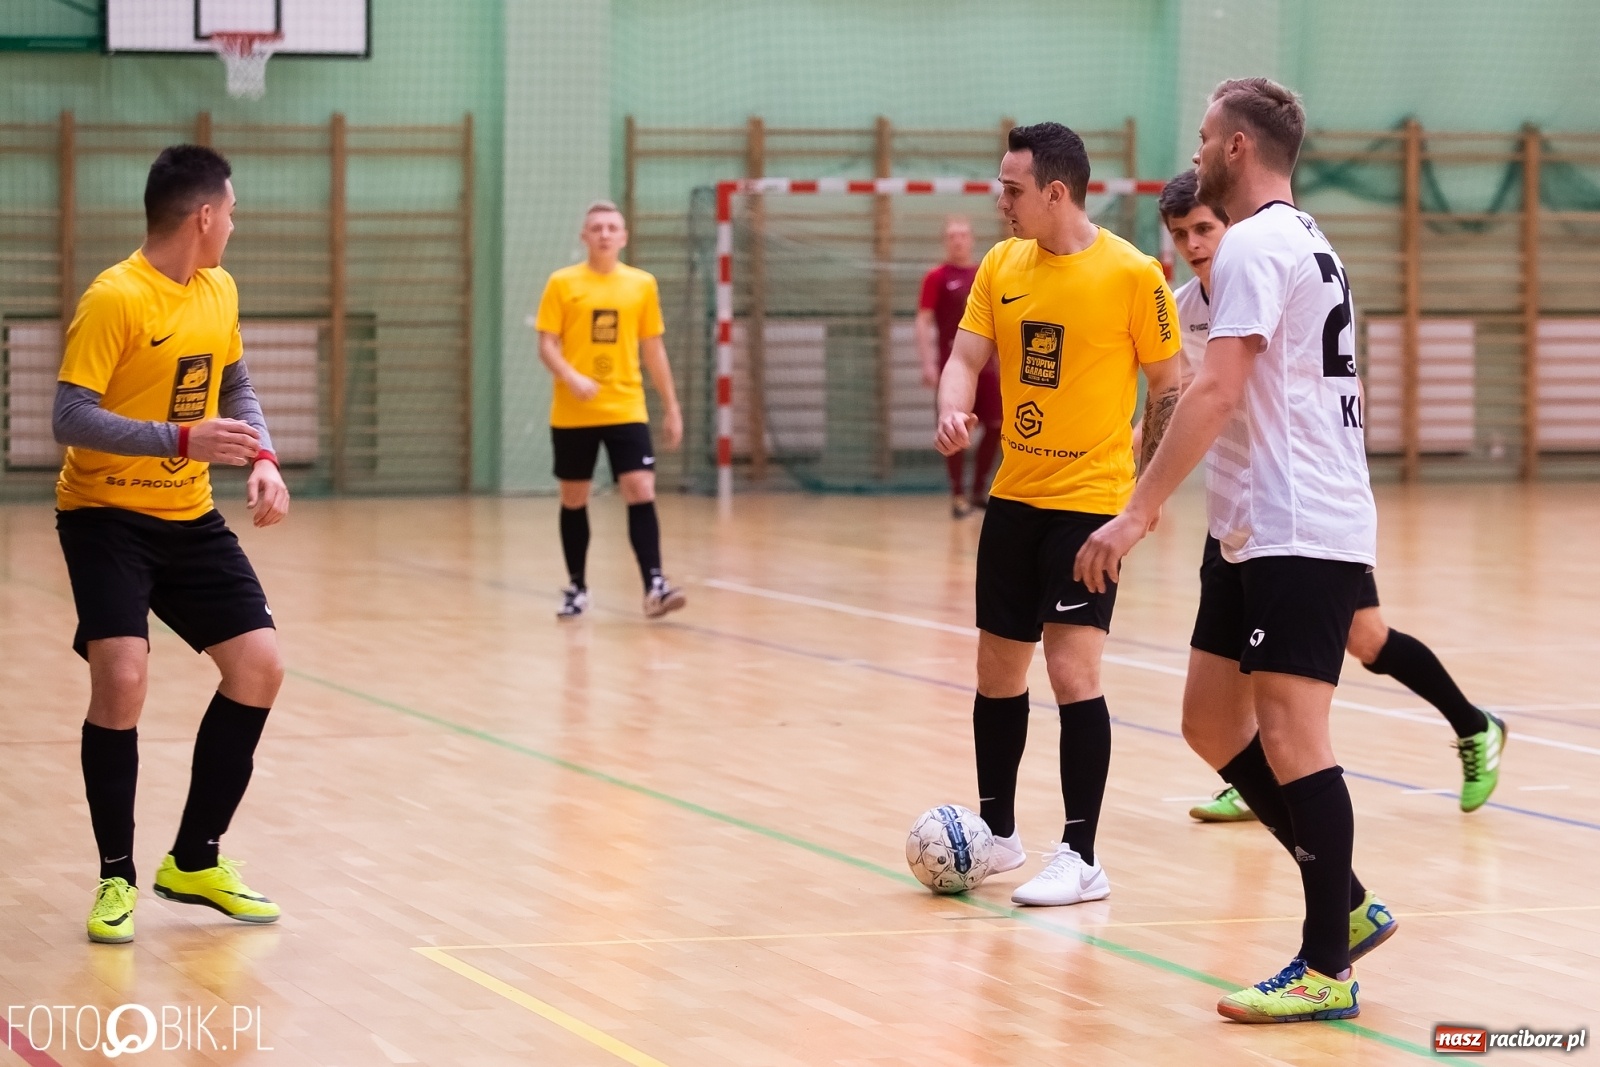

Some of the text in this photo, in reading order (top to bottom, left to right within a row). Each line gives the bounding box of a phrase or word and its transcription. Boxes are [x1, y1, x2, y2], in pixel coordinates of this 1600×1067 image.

[1153, 285, 1172, 343] WINDAR
[1026, 356, 1056, 369] STOPIW
[1025, 365, 1055, 378] GARAGE
